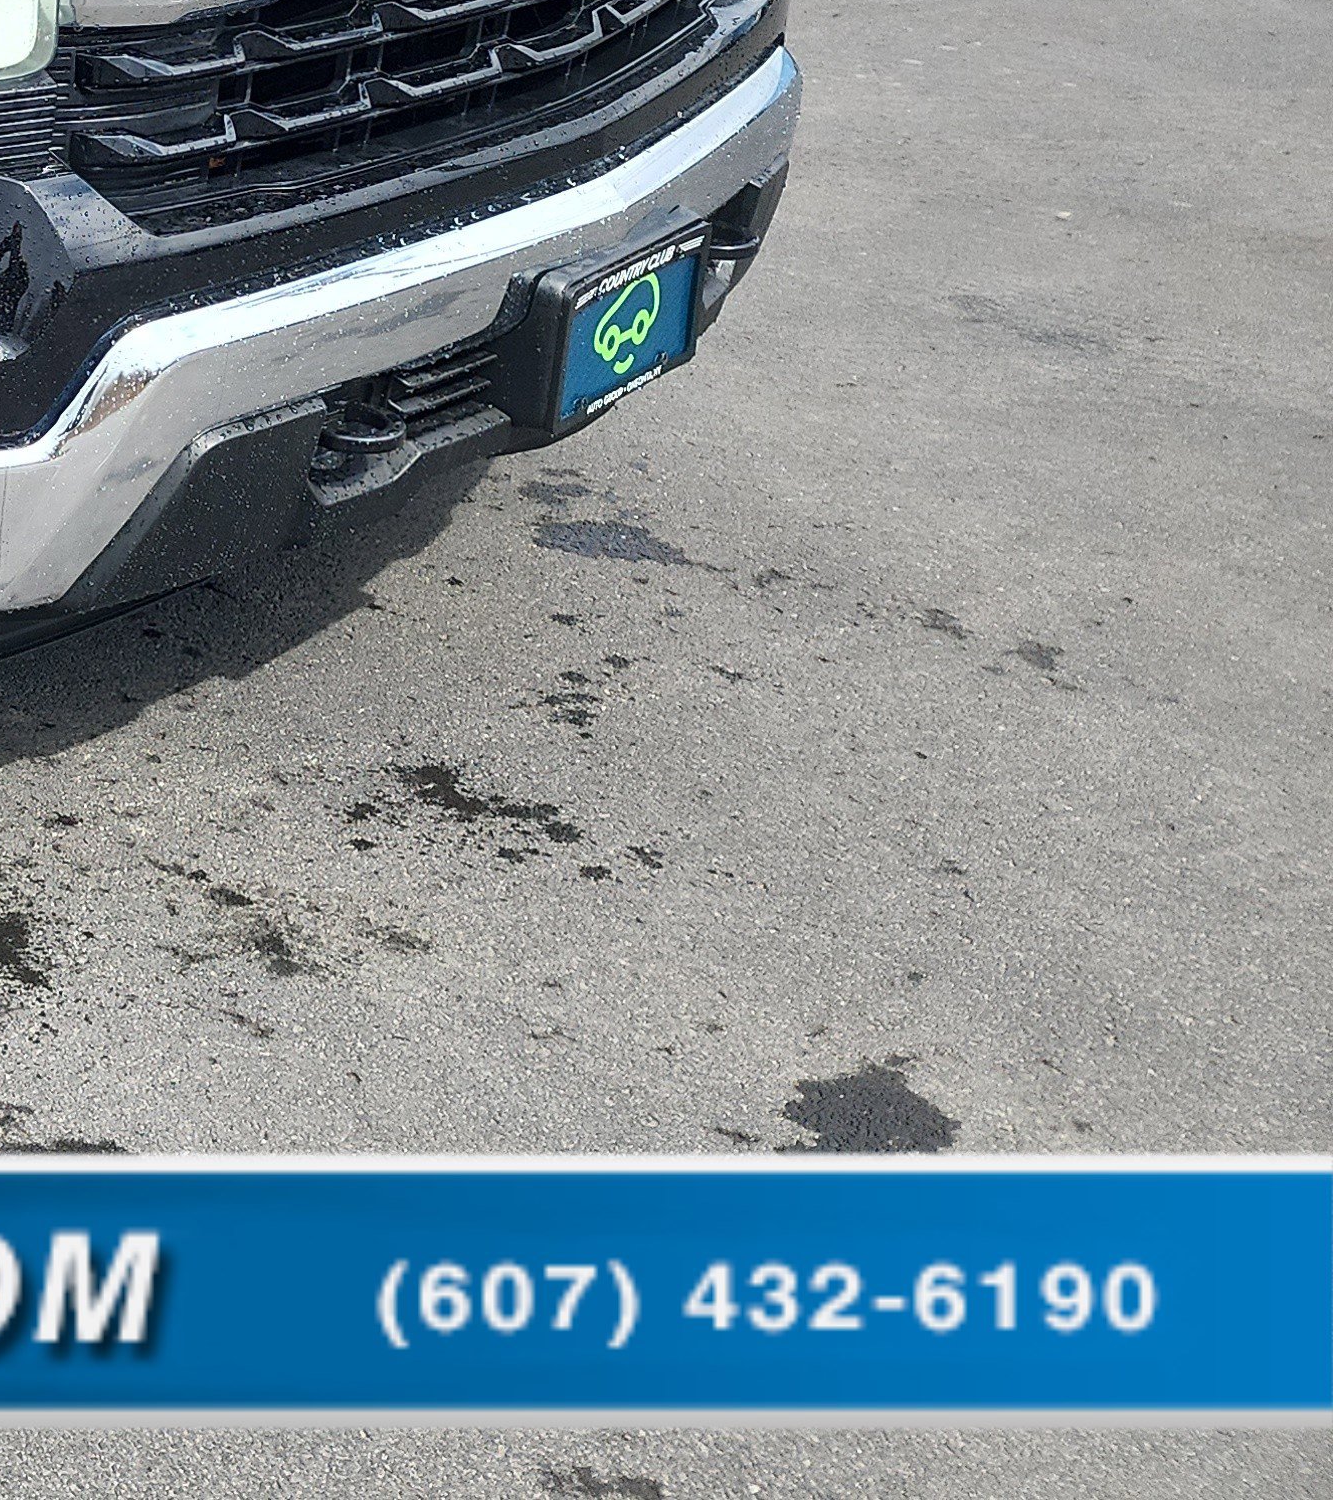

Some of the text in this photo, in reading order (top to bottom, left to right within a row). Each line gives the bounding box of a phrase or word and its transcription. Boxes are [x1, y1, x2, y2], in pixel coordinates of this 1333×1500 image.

[598, 244, 676, 295] COUNTRY CLUB
[586, 398, 603, 415] AUTO
